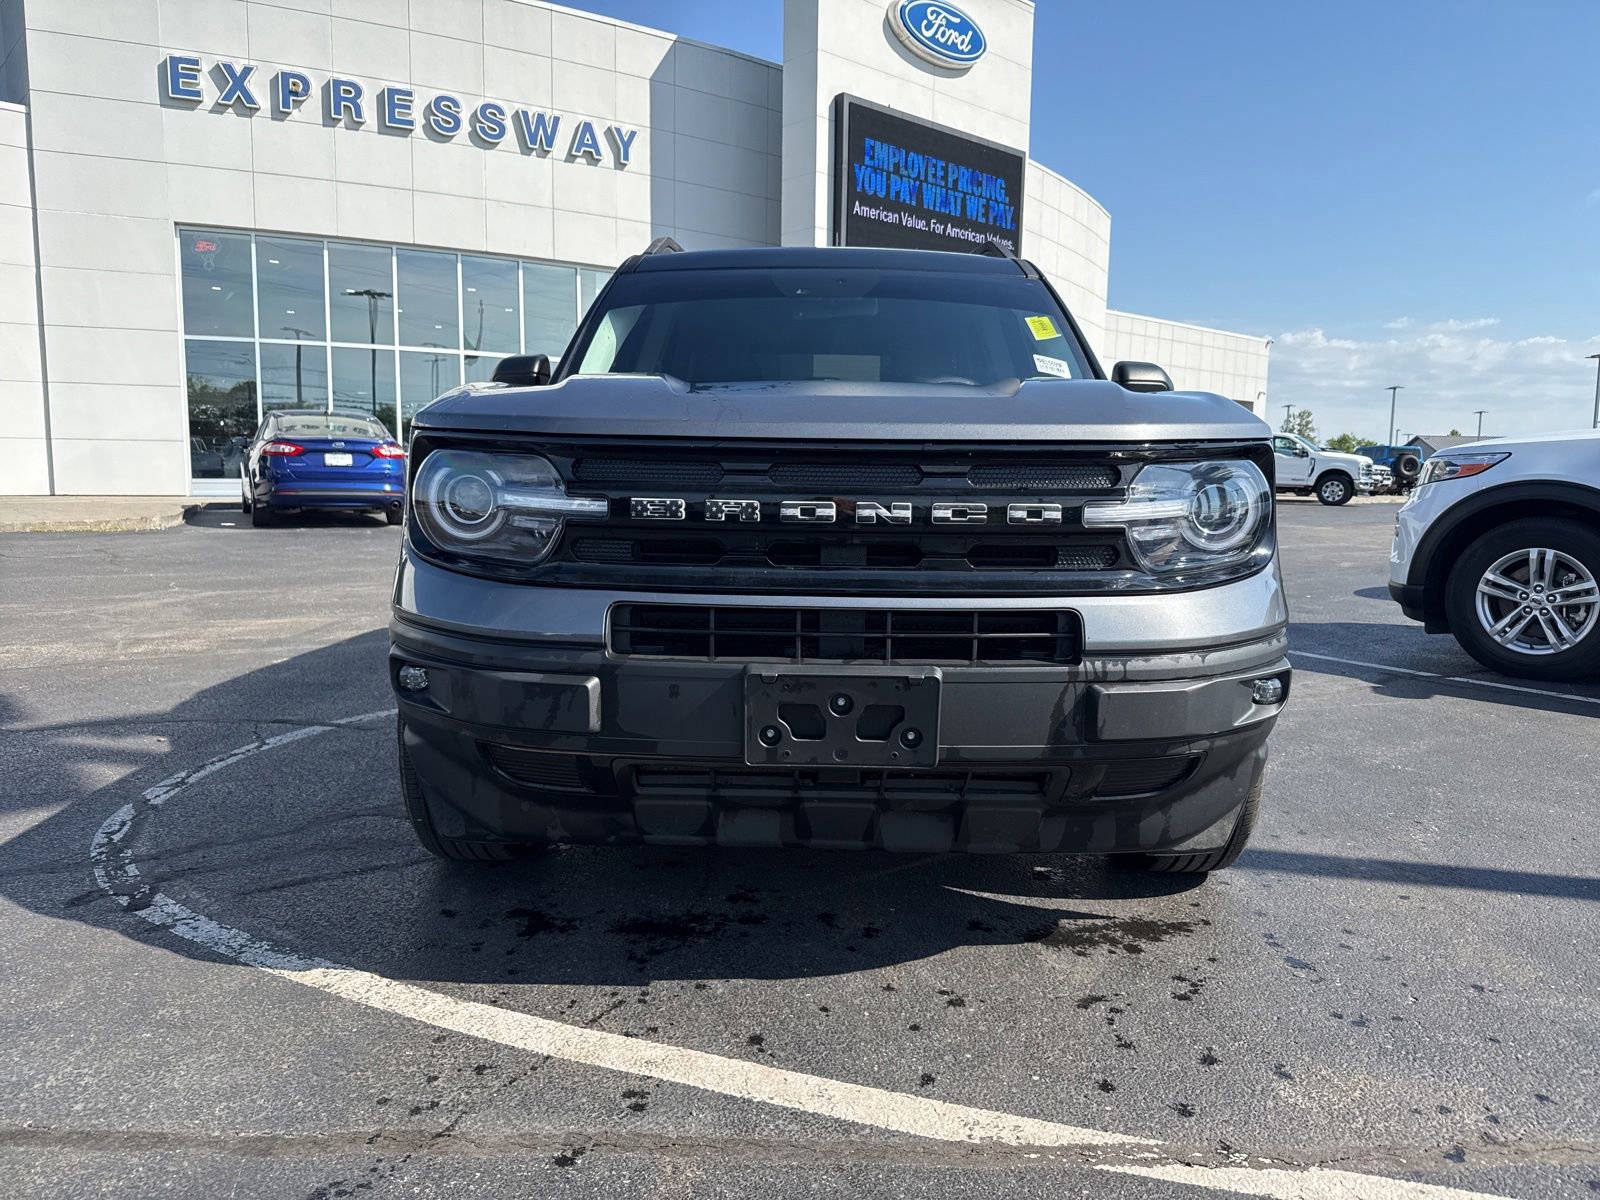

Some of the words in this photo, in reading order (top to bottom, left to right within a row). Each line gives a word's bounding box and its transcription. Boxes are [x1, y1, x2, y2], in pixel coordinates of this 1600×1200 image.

[921, 6, 973, 52] Ford
[166, 54, 639, 165] EXPRESSWAY
[854, 163, 887, 199] YOU
[890, 174, 919, 207] PAY
[922, 182, 963, 218] WHAT
[966, 194, 987, 224] WE
[988, 200, 1016, 231] PAY.
[864, 137, 945, 187] EMPLOYEE
[948, 162, 1009, 203] PRICING.
[853, 200, 899, 225] American
[901, 212, 928, 232] Value.
[930, 219, 944, 235] For
[946, 223, 985, 244] American
[630, 497, 1063, 525] BRONCO
